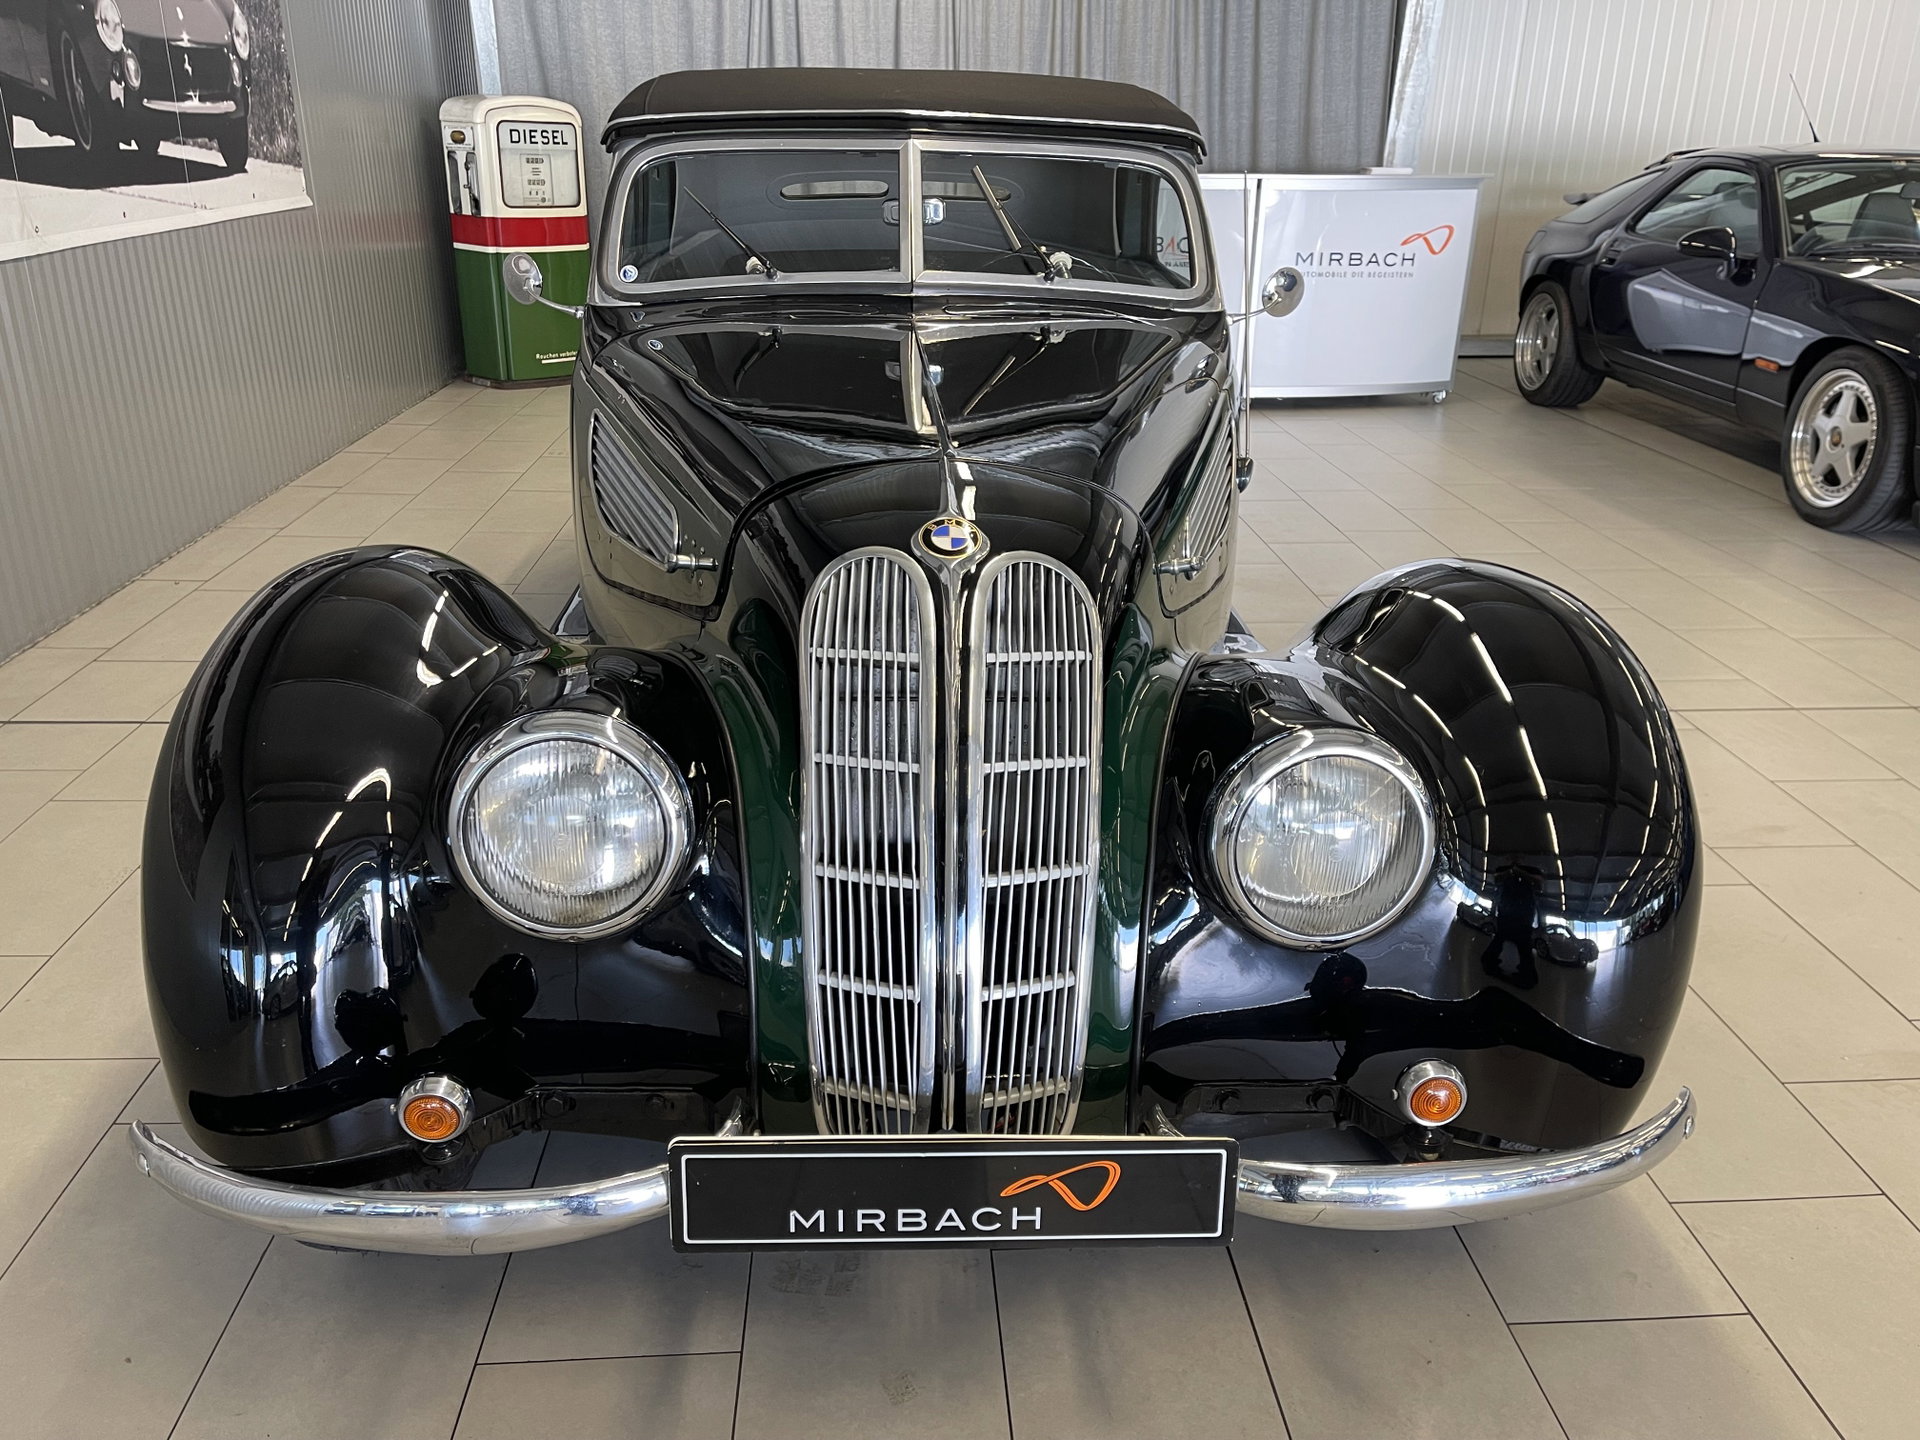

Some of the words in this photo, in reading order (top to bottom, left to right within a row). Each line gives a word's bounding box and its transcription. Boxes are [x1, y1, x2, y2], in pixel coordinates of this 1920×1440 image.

[509, 129, 569, 146] DIESEL
[1295, 252, 1416, 267] MIRBACH
[1303, 271, 1347, 279] TOMOBILE
[1351, 271, 1364, 279] DIE
[789, 1206, 1042, 1233] MIRBACH
